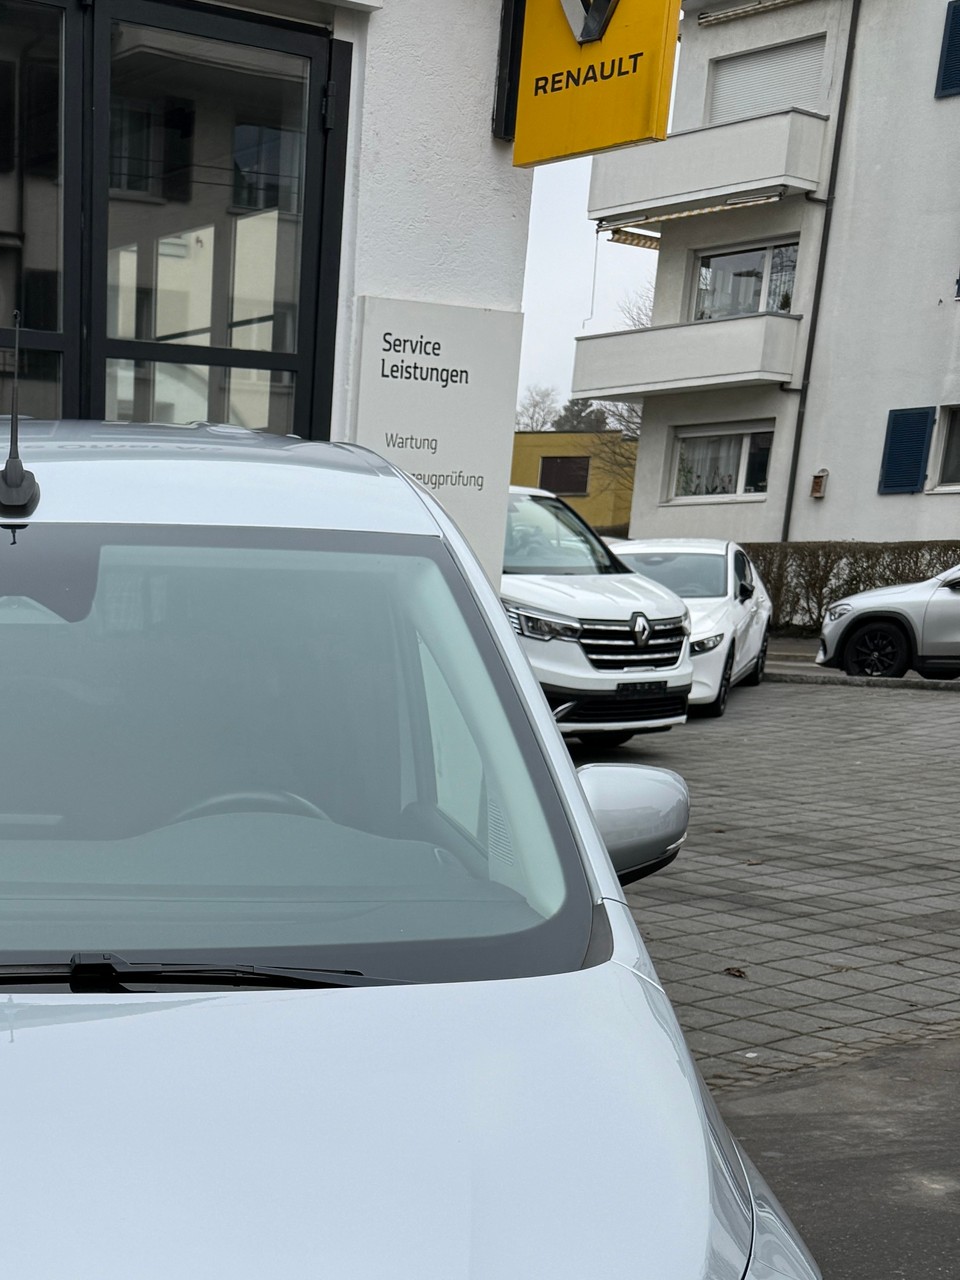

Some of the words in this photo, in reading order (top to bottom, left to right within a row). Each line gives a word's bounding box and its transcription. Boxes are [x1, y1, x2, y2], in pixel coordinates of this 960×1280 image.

[533, 52, 644, 96] RENAULT
[382, 332, 441, 356] Service
[381, 358, 469, 388] Leistungen
[385, 432, 438, 454] Wartung
